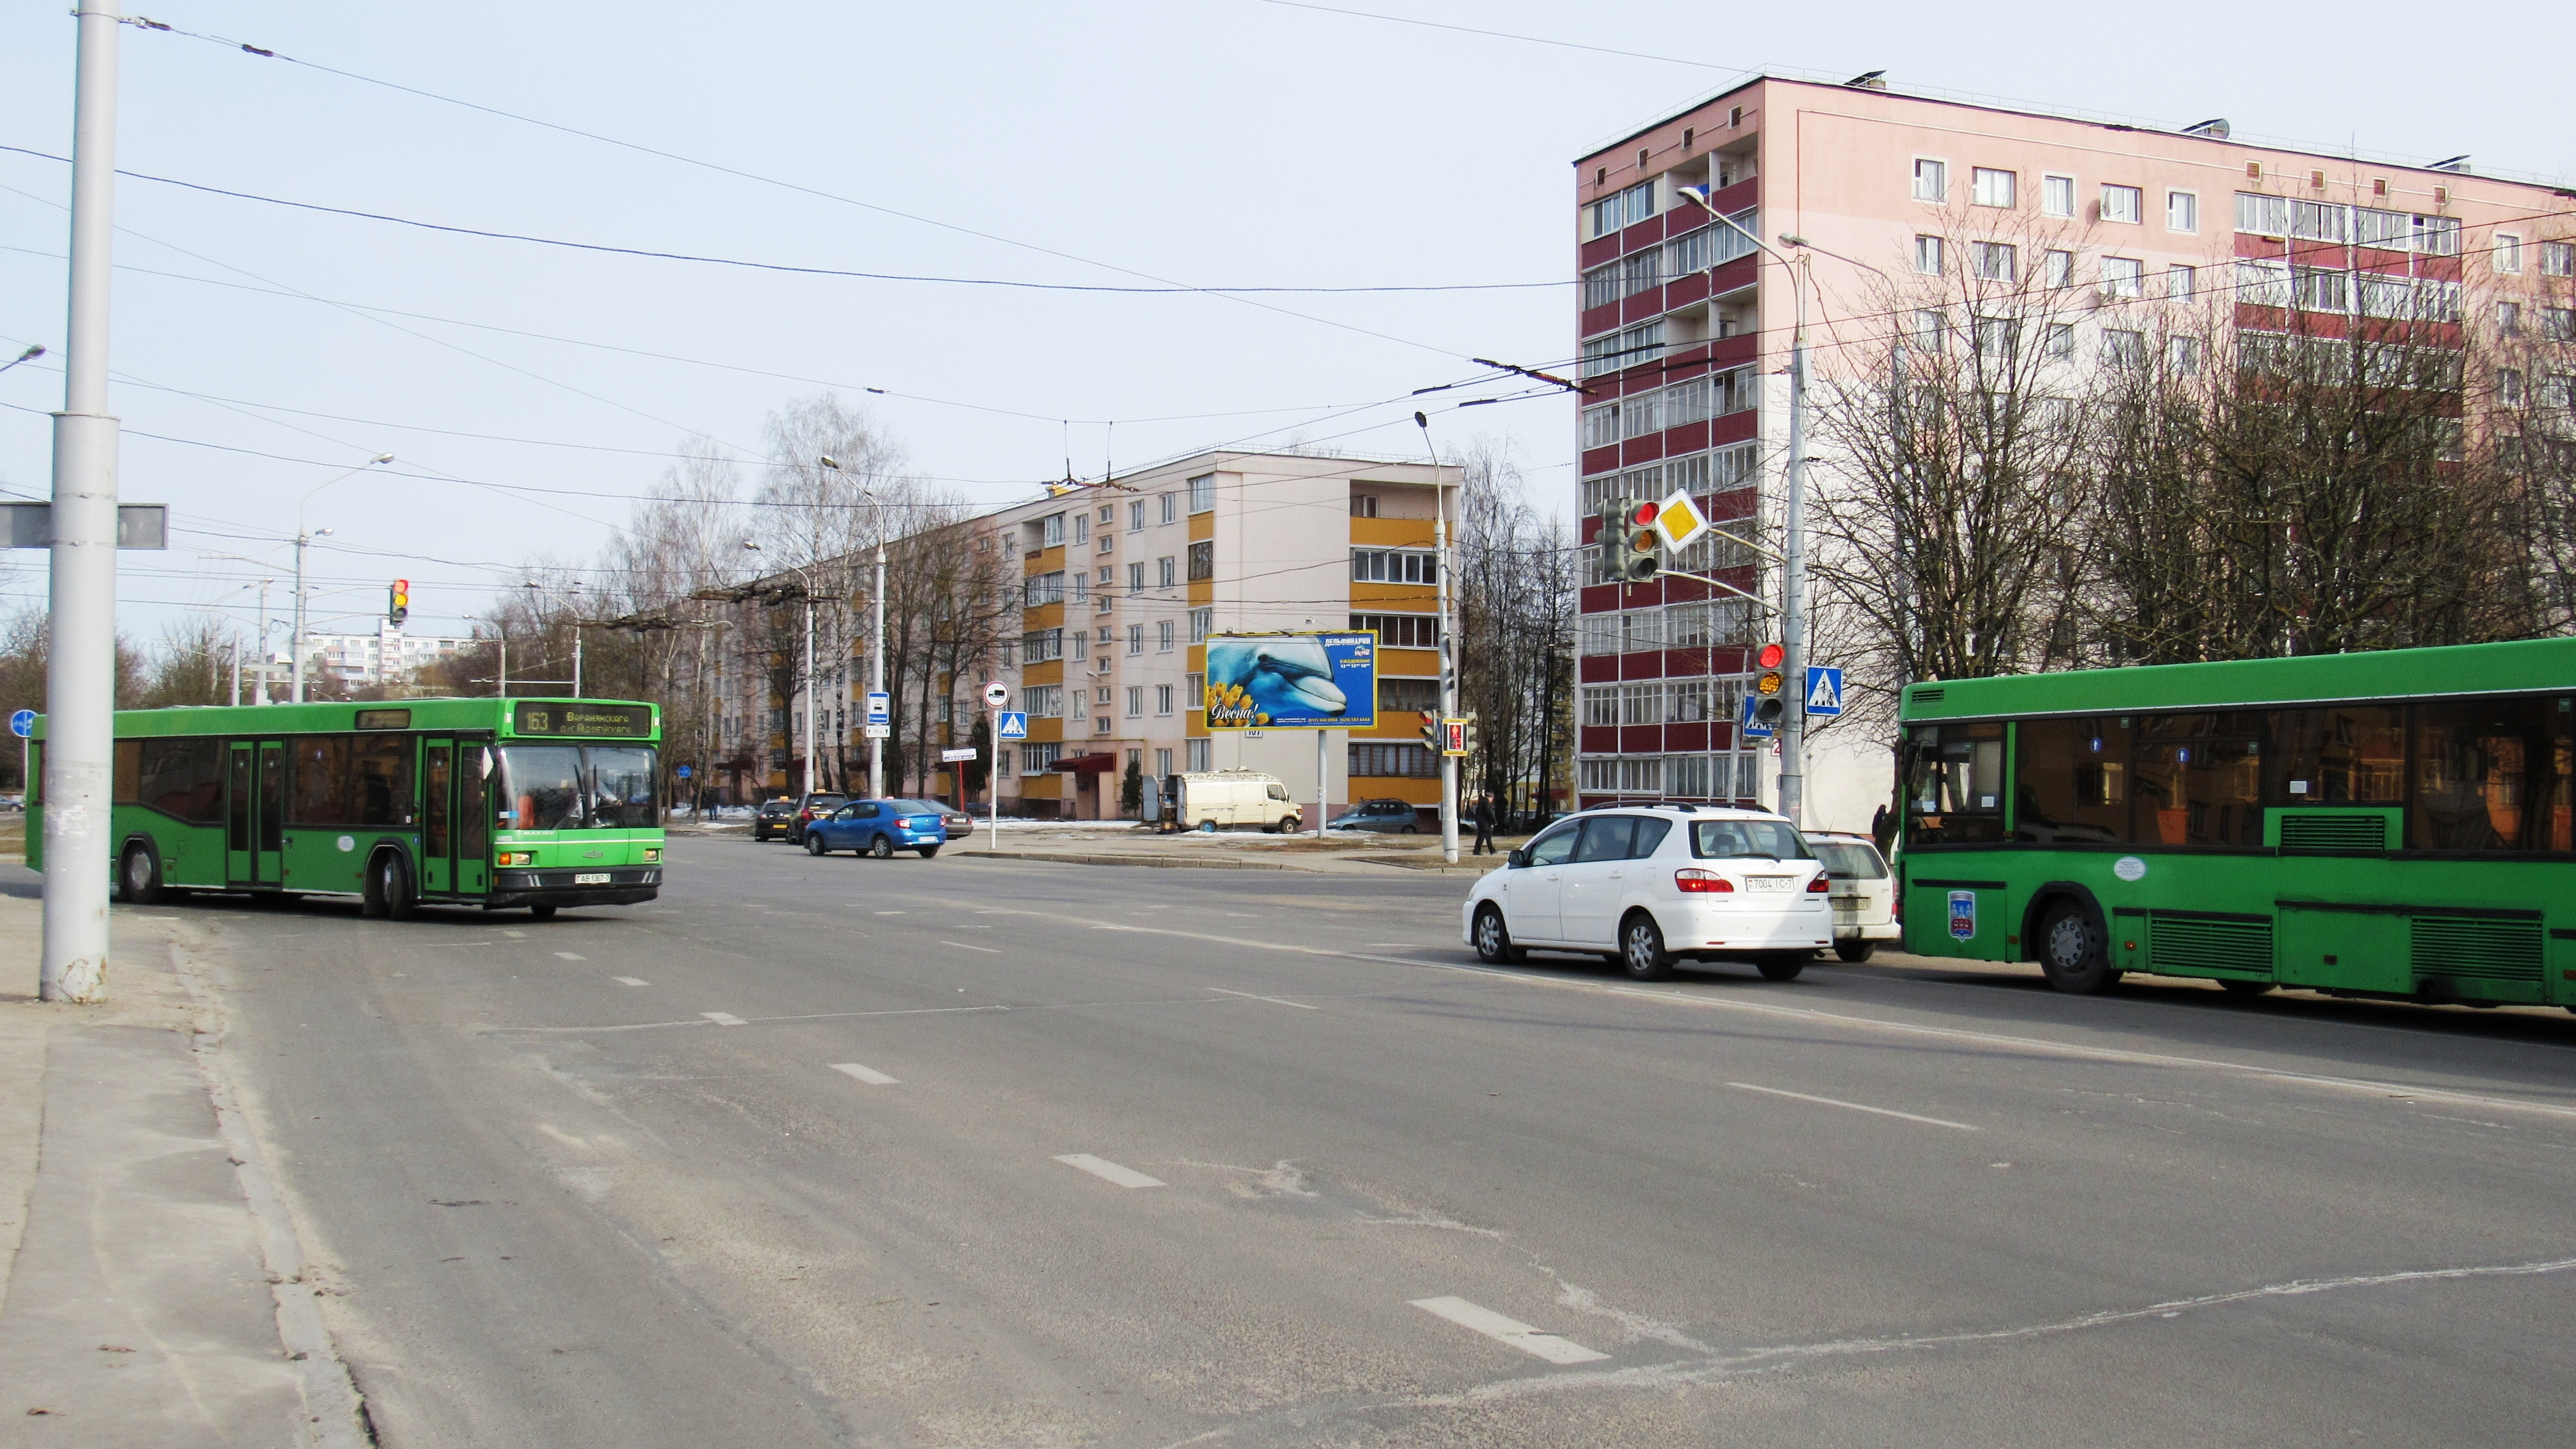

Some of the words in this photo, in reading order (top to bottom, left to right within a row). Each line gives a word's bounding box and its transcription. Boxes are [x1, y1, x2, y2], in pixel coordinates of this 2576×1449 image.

[1325, 637, 1371, 647] ДЕЛЬФИНАРИЙ
[1211, 703, 1259, 721] Весна!
[526, 712, 548, 731] 163
[1754, 879, 1772, 888] 7004
